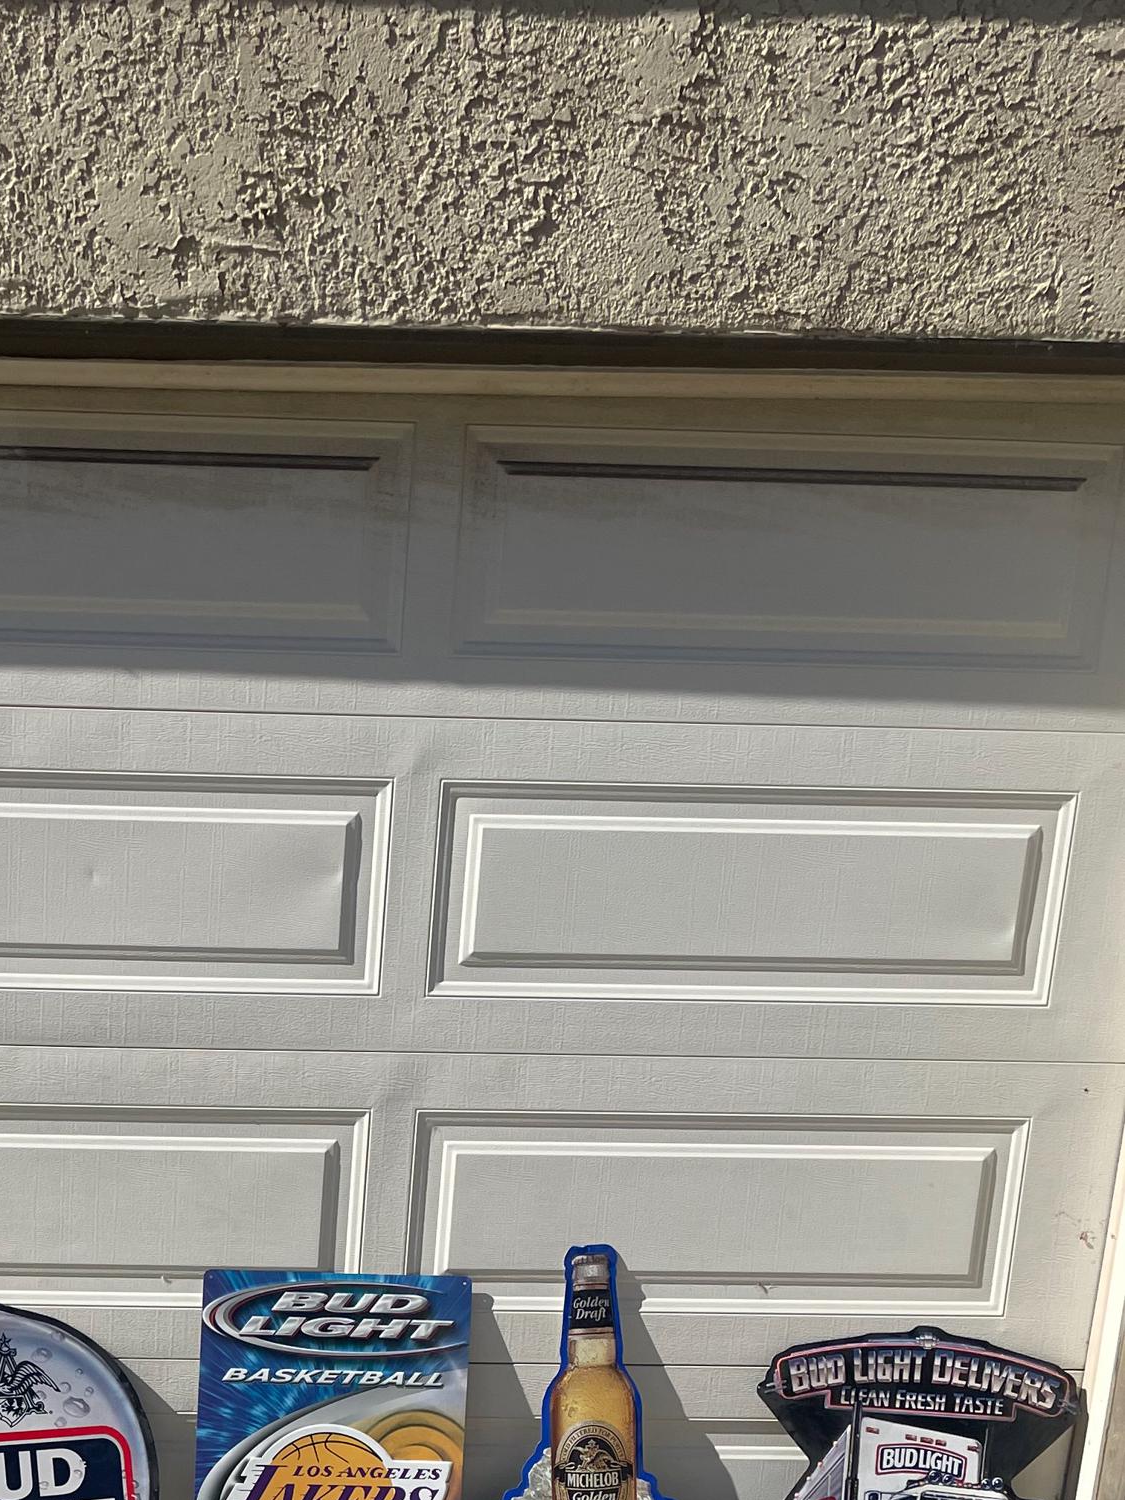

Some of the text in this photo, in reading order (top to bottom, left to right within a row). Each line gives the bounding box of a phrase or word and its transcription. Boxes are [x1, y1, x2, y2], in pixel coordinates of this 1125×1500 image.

[270, 1290, 430, 1315] BUD
[573, 1296, 610, 1309] Golden
[575, 1306, 606, 1322] Draft
[238, 1314, 456, 1342] LIGHT
[221, 1366, 445, 1388] BASKETBALL
[788, 1347, 1061, 1410] BUD LIGHT DELIVERS
[895, 1389, 947, 1412] FRESH
[953, 1392, 1004, 1415] TASTE
[292, 1464, 444, 1481] LOS ANGELES
[882, 1448, 962, 1476] BUD LIGHT
[567, 1471, 619, 1489] MICHELOB
